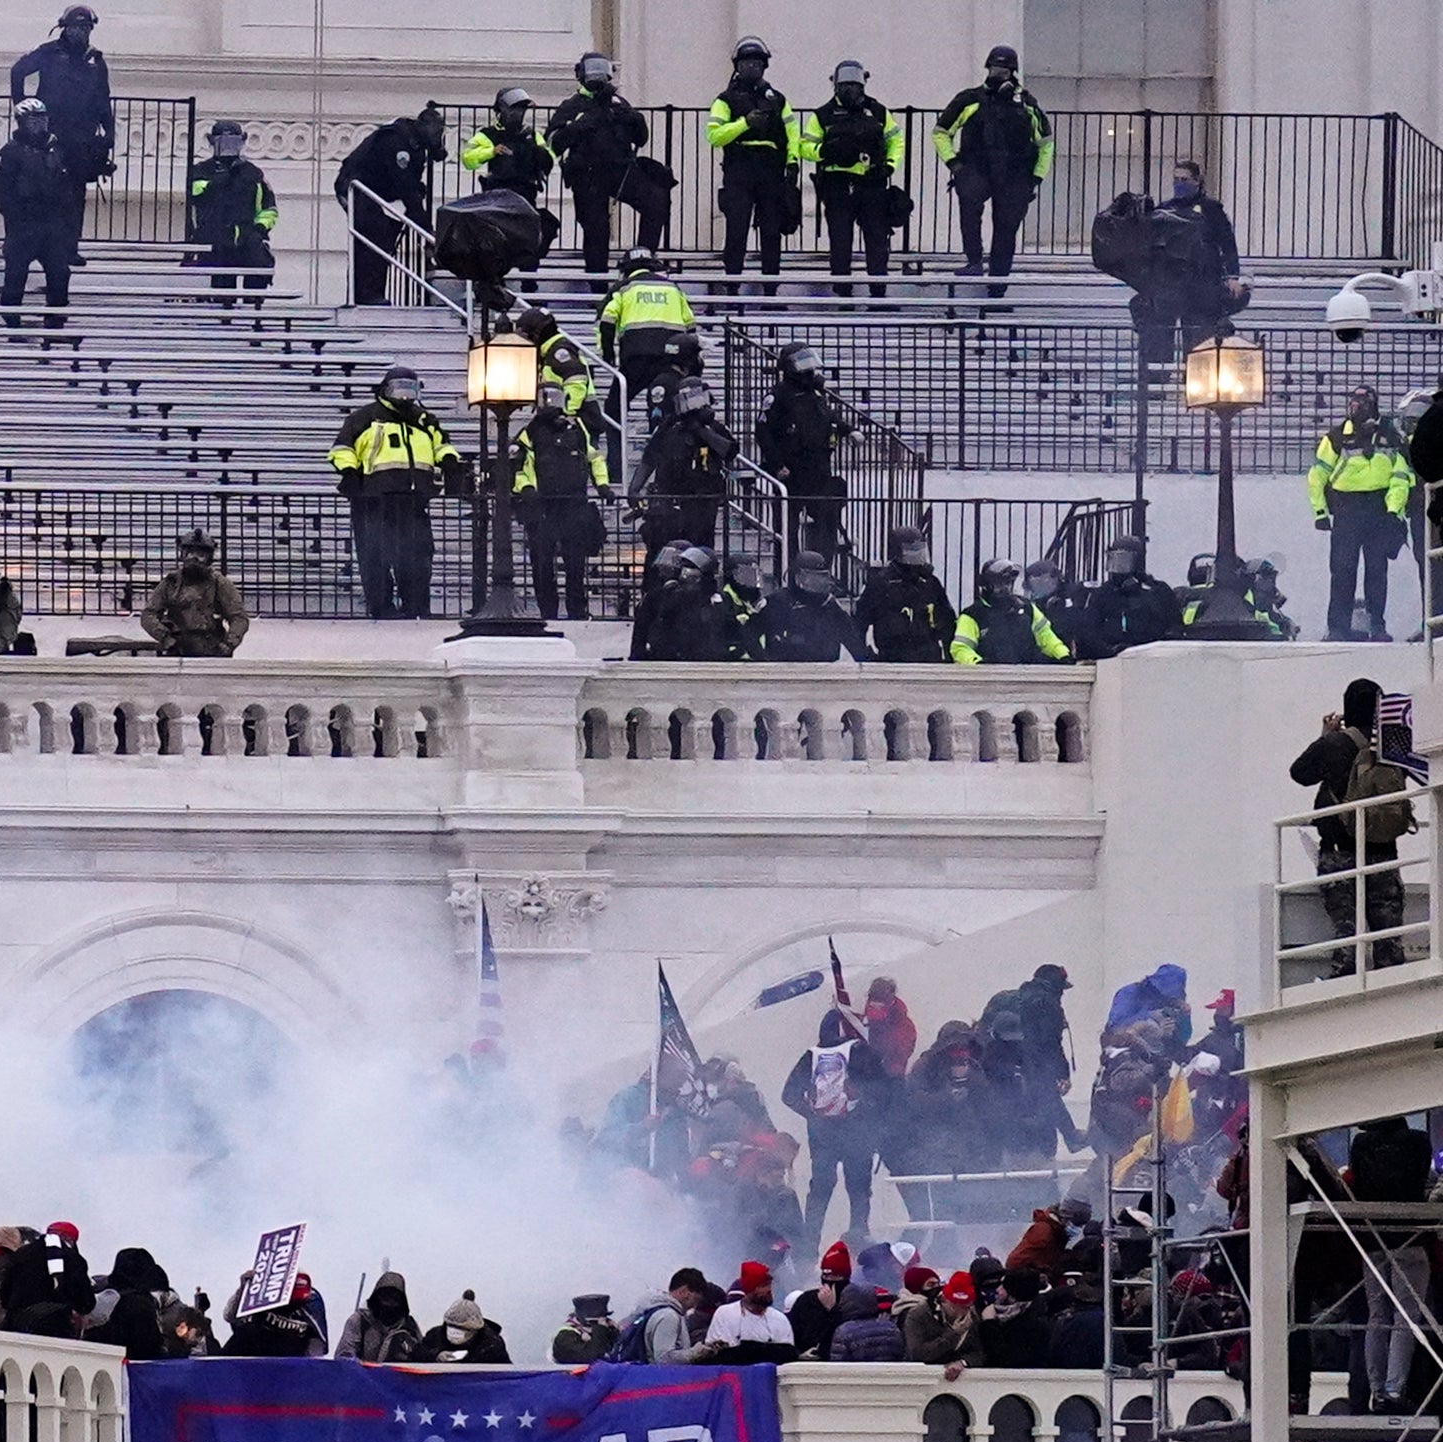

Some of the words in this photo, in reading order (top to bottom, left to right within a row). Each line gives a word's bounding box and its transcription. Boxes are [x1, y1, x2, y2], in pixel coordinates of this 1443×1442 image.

[636, 292, 668, 304] POLICE
[249, 1250, 270, 1295] 2020
[264, 1229, 296, 1302] TRUMP
